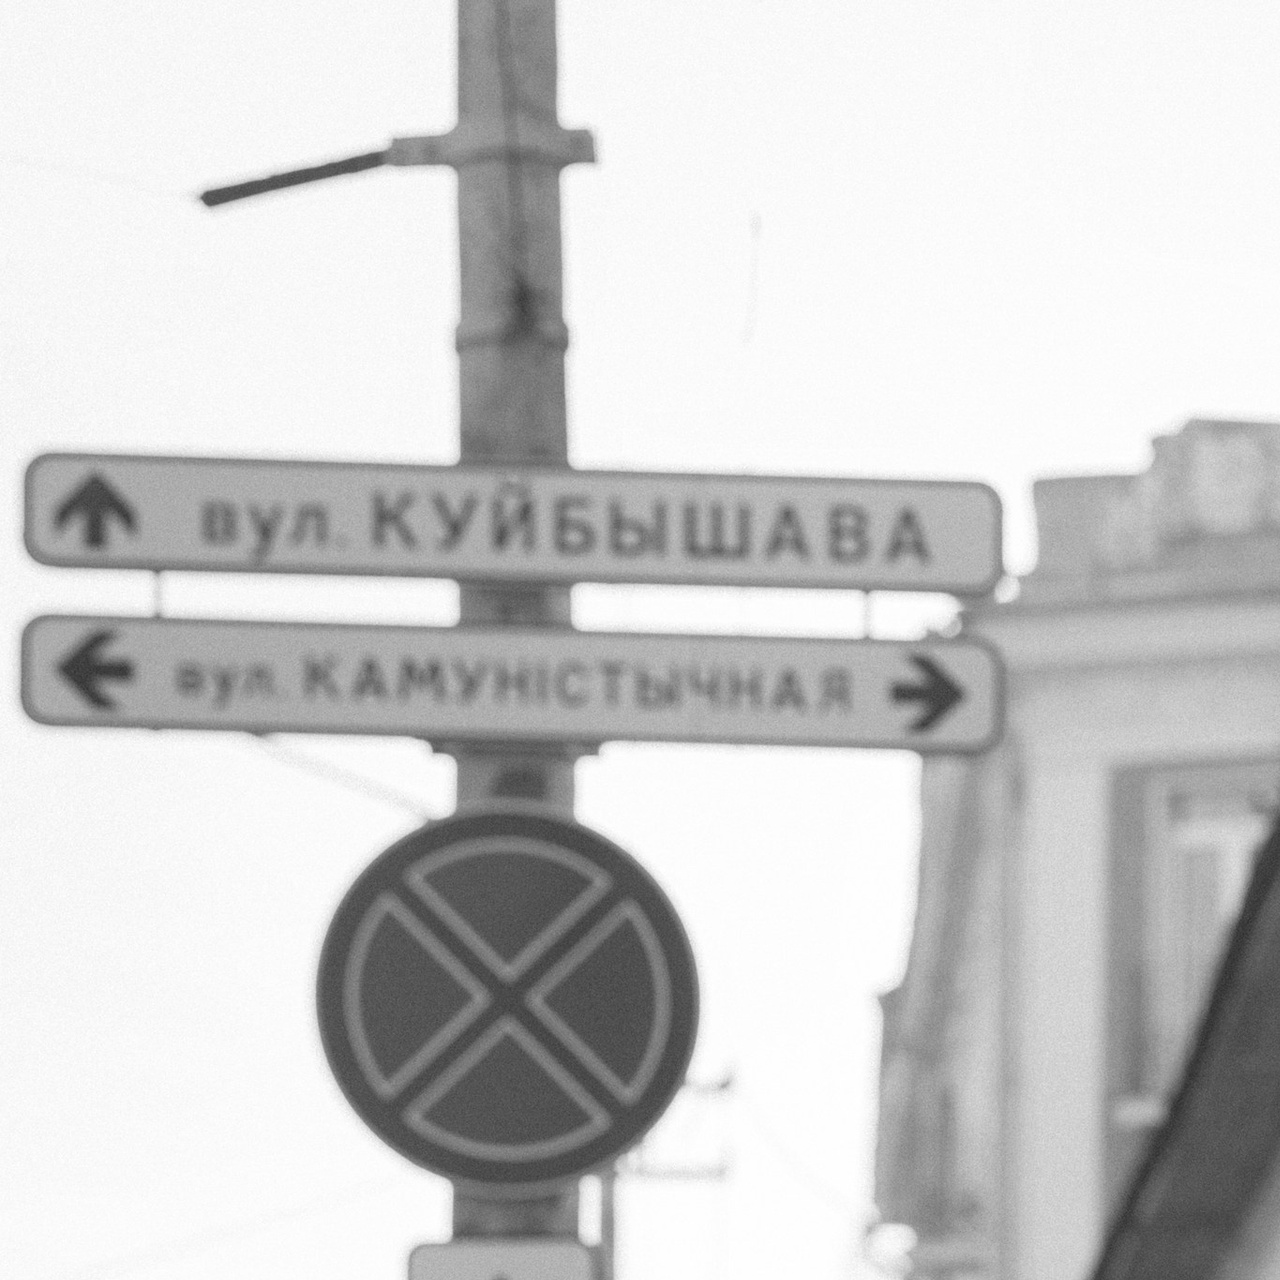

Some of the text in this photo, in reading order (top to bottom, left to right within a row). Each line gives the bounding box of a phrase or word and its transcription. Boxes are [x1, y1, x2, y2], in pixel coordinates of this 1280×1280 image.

[201, 481, 934, 564] вул. КУЙБЫШАВА
[302, 655, 853, 714] КАМУНІСТЫЧНАЯ
